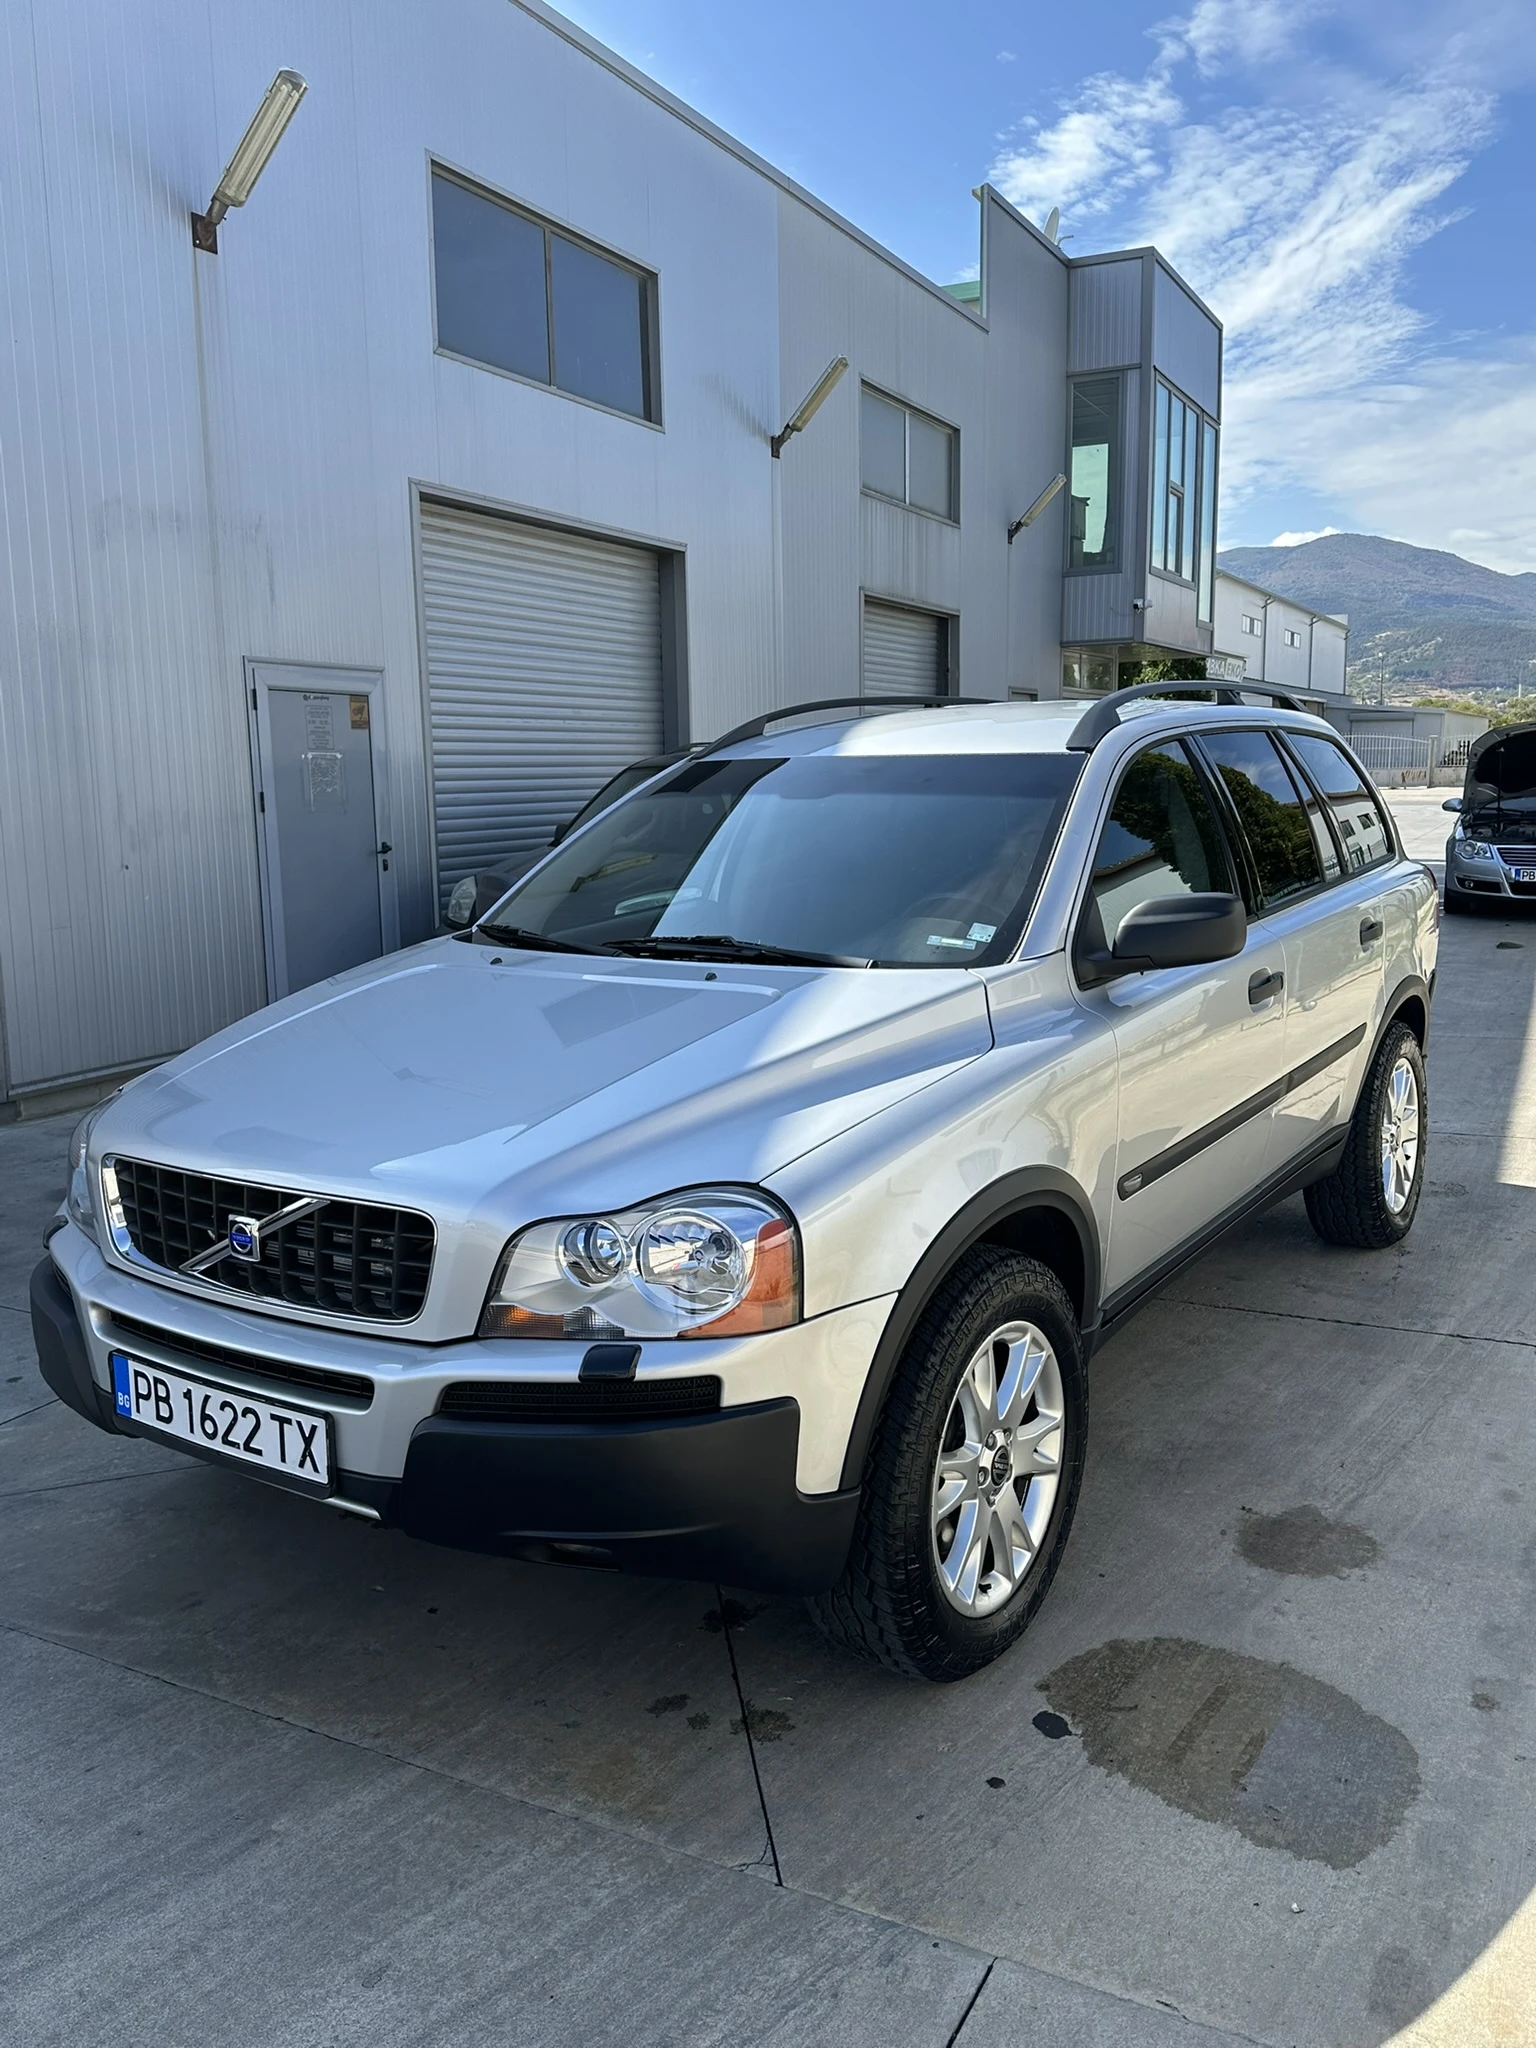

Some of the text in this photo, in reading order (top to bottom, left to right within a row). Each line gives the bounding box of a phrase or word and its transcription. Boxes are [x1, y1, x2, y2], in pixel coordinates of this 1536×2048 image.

[1522, 870, 1536, 880] PB
[117, 1391, 130, 1409] BG
[133, 1368, 321, 1474] PB 1622 TX
